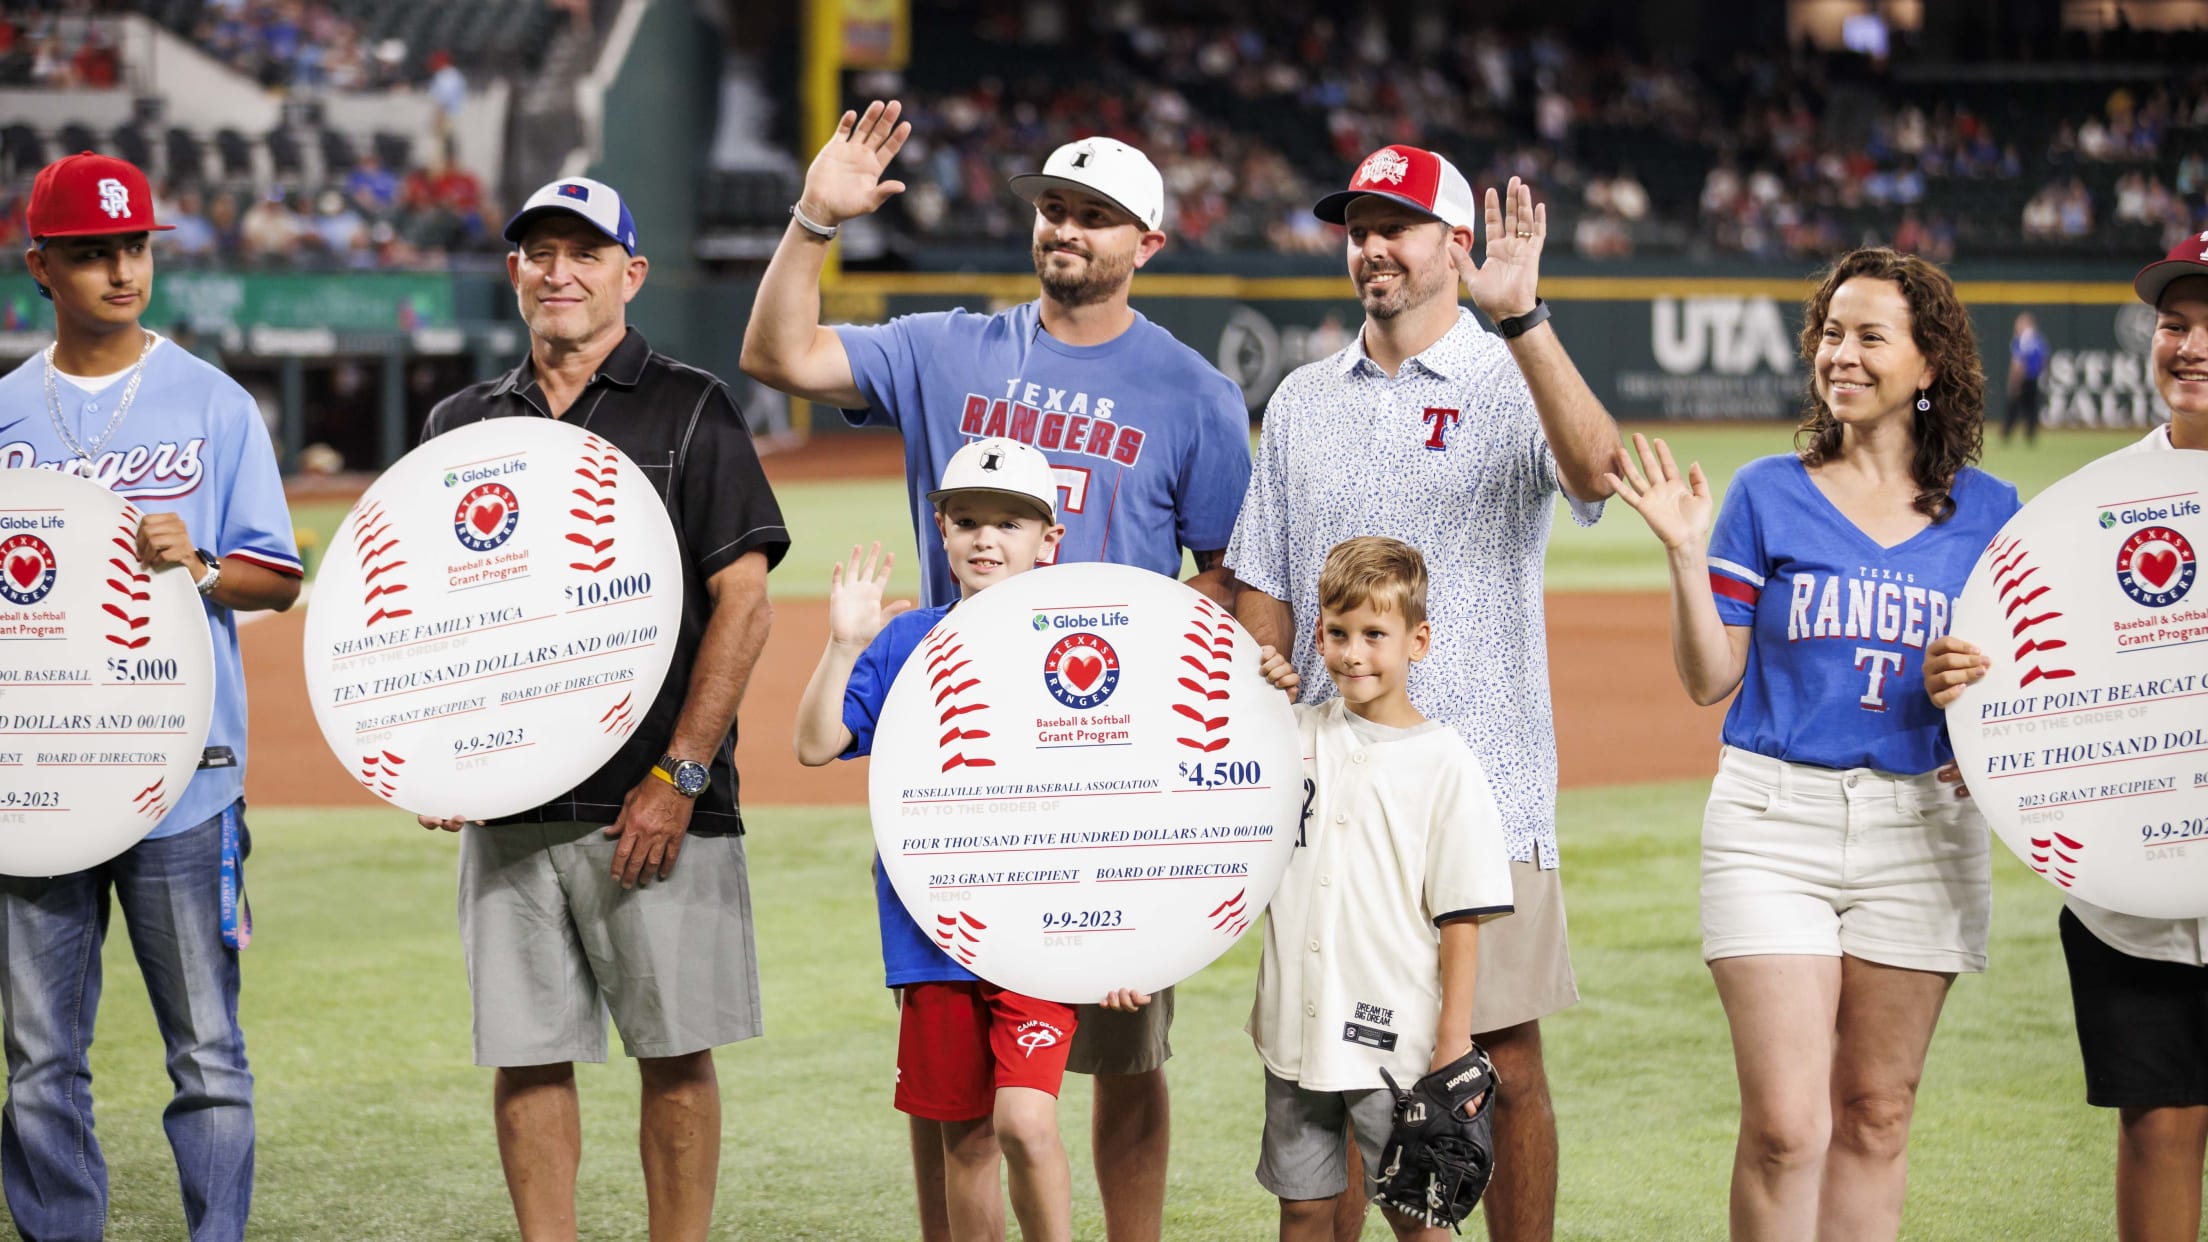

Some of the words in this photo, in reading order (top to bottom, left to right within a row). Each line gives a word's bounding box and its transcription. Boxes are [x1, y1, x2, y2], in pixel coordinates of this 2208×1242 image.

[1653, 295, 1793, 374] UTA
[1006, 378, 1115, 419] TEXAS
[959, 393, 1146, 468] RANGERS
[1423, 408, 1459, 451] T
[462, 467, 500, 482] Globe
[503, 460, 527, 474] Life
[462, 486, 510, 507] TEXAS
[0, 516, 38, 529] Globe
[42, 516, 65, 529] Life
[2121, 508, 2168, 525] Globe
[2171, 501, 2201, 517] Life
[458, 517, 517, 549] RANGERS
[2126, 530, 2182, 552] TEXAS
[1, 537, 48, 556] TEXAS
[447, 559, 483, 574] Baseball
[485, 558, 492, 566] &
[495, 549, 529, 564] Softball
[449, 573, 479, 586] Grant
[482, 564, 528, 579] Program
[1859, 566, 1915, 583] TEXAS
[565, 572, 651, 607] $10,000
[2123, 569, 2193, 603] RANGERS
[23, 612, 29, 620] &
[32, 612, 66, 621] Softball
[1053, 615, 1098, 629] Globe
[1101, 612, 1129, 626] Life
[1787, 573, 1959, 650] RANGER
[20, 625, 64, 637] Program
[333, 629, 410, 656] SHAWNEE
[414, 616, 476, 639] FAMILY
[480, 606, 523, 626] YMCA
[2114, 616, 2158, 631] Baseball
[2161, 616, 2168, 624] &
[1055, 636, 1109, 656] TEXAS
[2118, 632, 2155, 646] Grant
[332, 660, 357, 672] PAY
[359, 656, 377, 667] TO
[380, 651, 403, 663] THE
[407, 641, 448, 658] ORDER
[452, 638, 469, 649] OF
[334, 682, 368, 702] TEN
[373, 663, 470, 697] THOUSAND
[475, 645, 558, 674] DOLLARS
[562, 636, 602, 657] AND
[607, 625, 658, 648] 00/100
[24, 669, 91, 682] BASEBALL
[107, 657, 178, 685] $5,000
[1854, 647, 1905, 711] T
[500, 686, 541, 703] BOARD
[545, 682, 561, 694] OF
[564, 667, 634, 691] DIRECTORS
[1049, 676, 1116, 706] RANGERS
[1981, 698, 2038, 719] PILOT
[2043, 688, 2102, 711] POINT
[2107, 675, 2196, 703] BEARCAT
[14, 714, 91, 729] DOLLARS
[96, 714, 132, 729] AND
[137, 714, 185, 729] 00/100
[355, 718, 378, 731] 2023
[381, 709, 421, 726] GRANT
[423, 697, 486, 718] RECIPIENT
[1036, 716, 1078, 728] Baseball
[1080, 716, 1088, 725] &
[1091, 714, 1131, 725] Softball
[1982, 725, 2012, 738] PAY
[2016, 721, 2036, 733] TO
[2040, 717, 2069, 730] THE
[2073, 708, 2124, 726] ORDER
[2128, 707, 2148, 719] OF
[356, 731, 392, 745] MEMO
[454, 728, 524, 754] 9-9-2023
[1038, 730, 1073, 742] Grant
[1077, 729, 1129, 743] Program
[37, 752, 77, 763] BOARD
[80, 752, 97, 763] OF
[99, 752, 167, 763] DIRECTORS
[456, 758, 489, 771] DATE
[1987, 751, 2035, 773] FIVE
[2042, 735, 2157, 766] THOUSAND
[1178, 761, 1261, 791] $4,500
[902, 785, 982, 799] RUSSELLVILLE
[985, 784, 1023, 795] YOUTH
[1026, 782, 1082, 793] BASEBALL
[1085, 779, 1160, 791] ASSOCIATION
[2018, 793, 2045, 808] 2023
[2049, 787, 2096, 804] GRANT
[2100, 776, 2176, 797] RECIPIENT
[902, 805, 929, 817] PAY
[934, 804, 953, 815] TO
[956, 803, 984, 815] THE
[989, 801, 1037, 813] ORDER
[1041, 800, 1060, 811] OF
[2020, 810, 2064, 825] MEMO
[902, 838, 940, 850] FOUR
[944, 834, 1020, 849] THOUSAND
[1023, 833, 1056, 845] FIVE
[1060, 830, 1130, 845] HUNDRED
[1133, 828, 1197, 841] DOLLARS
[1200, 826, 1230, 839] AND
[1233, 825, 1273, 837] 00/100
[2145, 847, 2186, 861] DATE
[929, 873, 955, 885] 2023
[958, 871, 1004, 885] GRANT
[1007, 869, 1080, 883] RECIPIENT
[1096, 866, 1143, 879] BOARD
[1147, 865, 1166, 877] OF
[1169, 863, 1248, 876] DIRECTORS
[929, 890, 972, 903] MEMO
[1042, 910, 1122, 929] 9-9-2023
[1044, 936, 1082, 948] DATE
[1354, 1010, 1366, 1020] BIG
[1357, 1001, 1381, 1014] DREAM
[1381, 1008, 1394, 1018] THE
[1017, 1019, 1038, 1032] CAMP
[1446, 1066, 1482, 1088] Wilson
